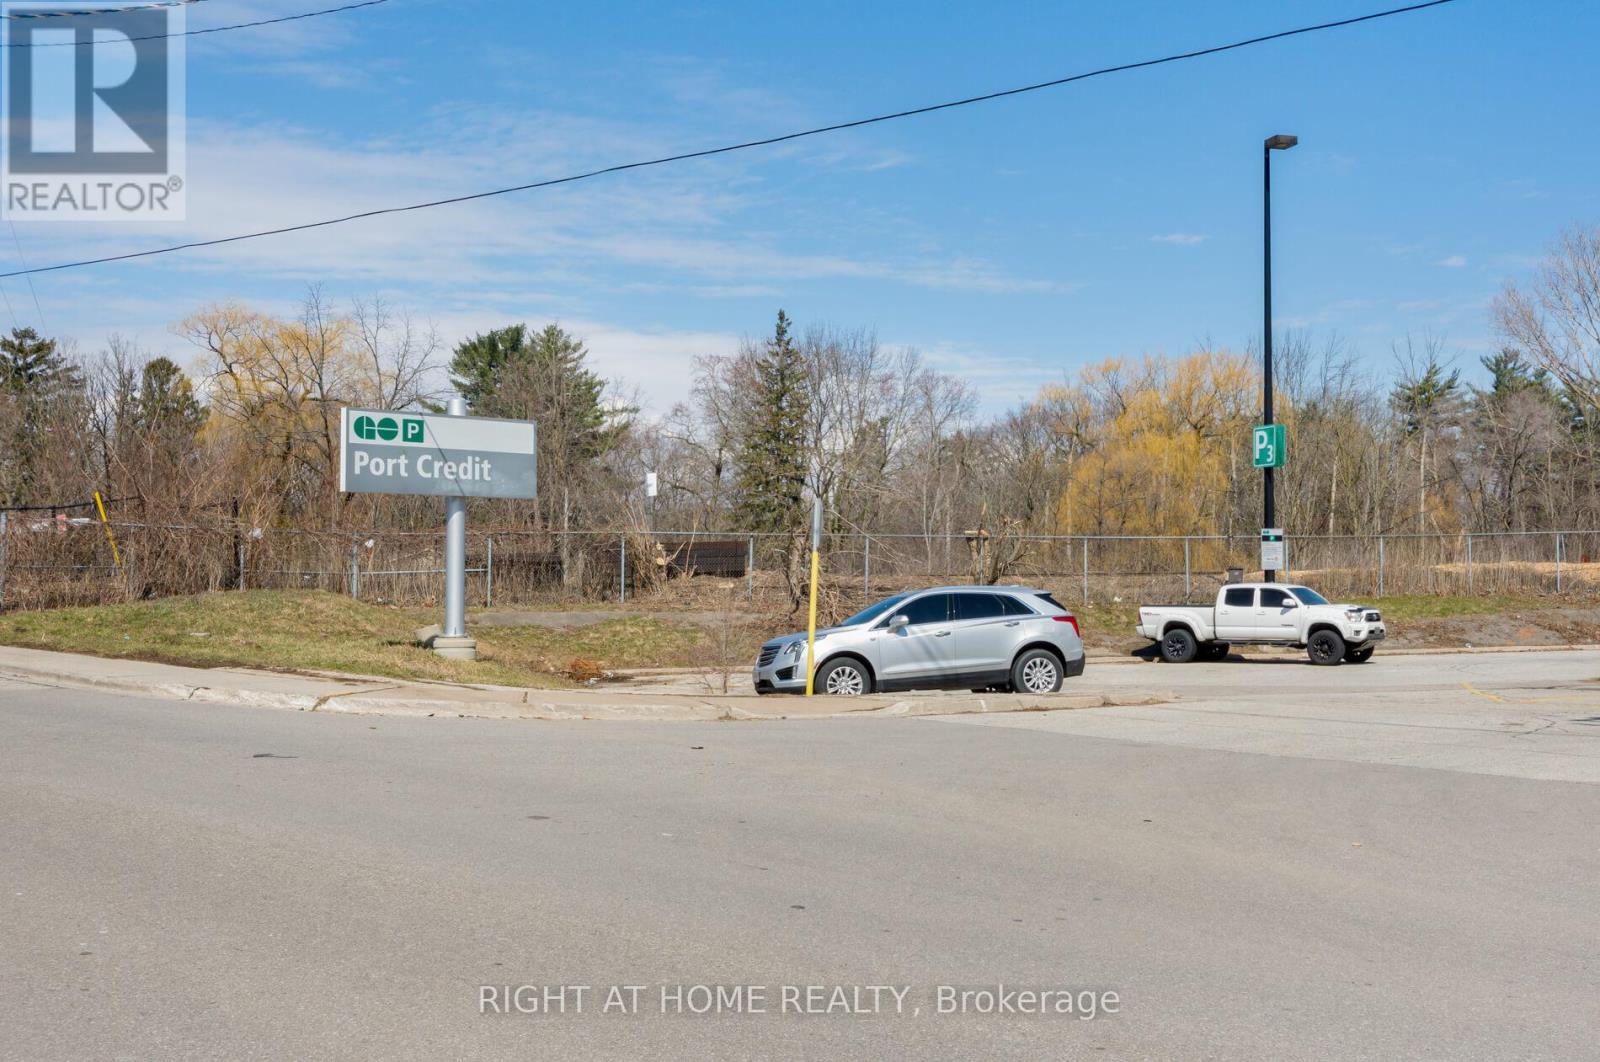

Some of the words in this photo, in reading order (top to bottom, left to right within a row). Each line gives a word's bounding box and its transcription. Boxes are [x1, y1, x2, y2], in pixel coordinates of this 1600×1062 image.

[354, 416, 398, 441] GO
[408, 423, 419, 439] P
[354, 450, 409, 477] Port
[416, 454, 492, 481] Credit
